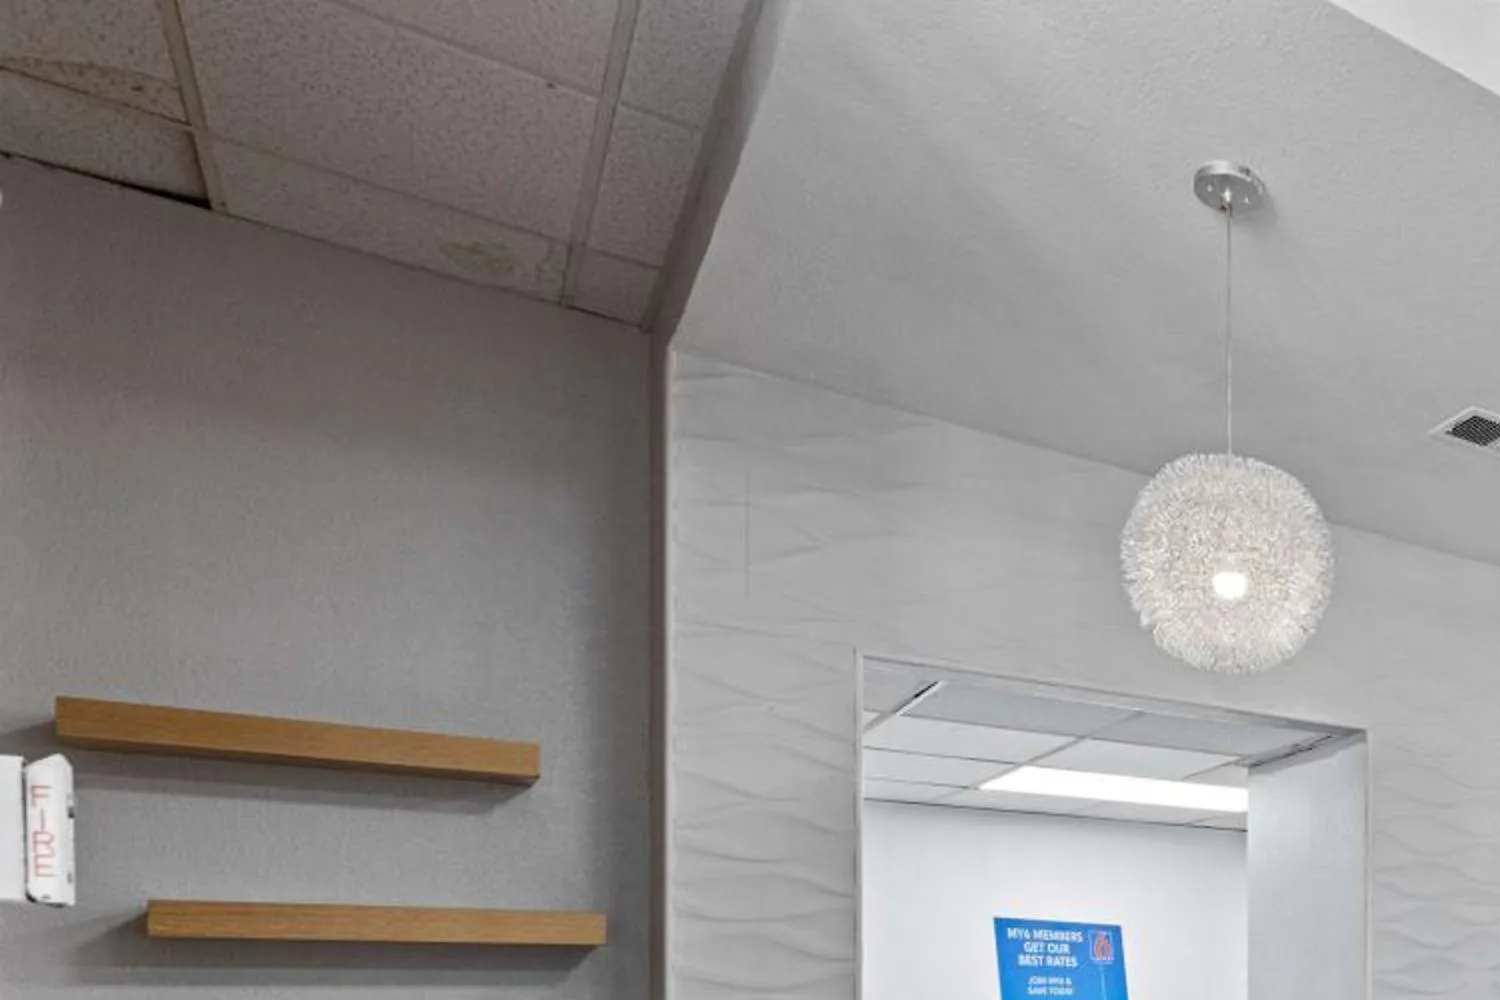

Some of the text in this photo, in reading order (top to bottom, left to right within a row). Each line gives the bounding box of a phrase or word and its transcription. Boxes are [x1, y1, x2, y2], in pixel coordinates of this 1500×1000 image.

[30, 785, 56, 877] FIRE
[1007, 927, 1083, 943] MY6 MEMBERS
[1024, 942, 1070, 955] GET OUR
[1018, 954, 1078, 968] BEST RATES
